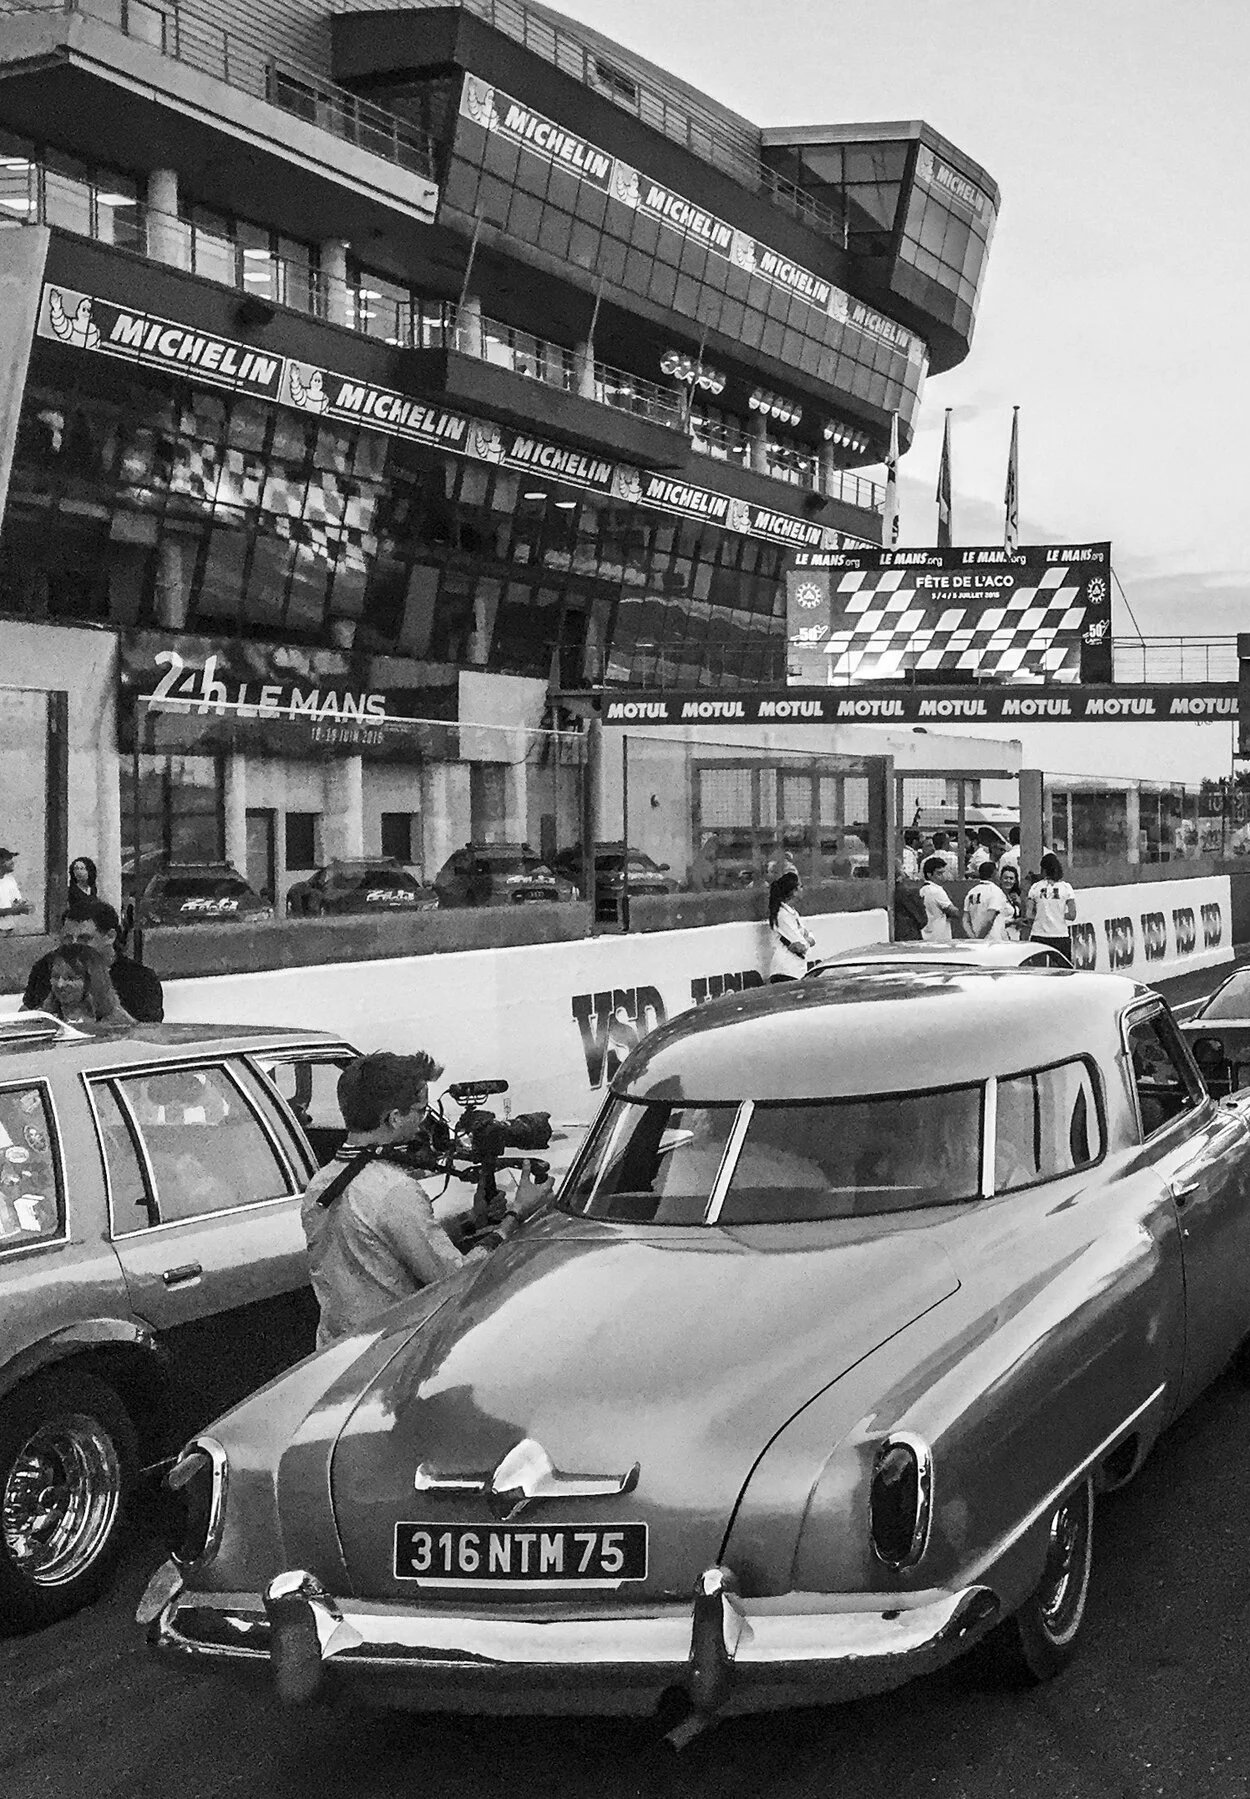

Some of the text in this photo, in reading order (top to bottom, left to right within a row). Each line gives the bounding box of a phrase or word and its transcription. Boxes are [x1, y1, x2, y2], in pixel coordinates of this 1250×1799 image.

[504, 104, 609, 178] MICHELIN
[646, 186, 732, 248] MICHELIN
[760, 252, 831, 303] MICHELIN
[852, 305, 909, 347] MICHELIN
[110, 314, 278, 385] MICHELIN
[336, 384, 466, 441] MICHELIN
[510, 437, 611, 484] MICHELIN
[646, 478, 728, 518] MICHELIN
[754, 512, 822, 545] MICHELIN
[795, 553, 809, 565] LE
[879, 553, 893, 565] LE
[962, 552, 976, 563] LE
[1046, 550, 1060, 562] LE
[916, 574, 1014, 588] FÊTE DE L'ACO
[237, 684, 283, 718] LE
[289, 688, 386, 725] MANS
[607, 702, 668, 719] MOTUL
[681, 702, 745, 718] MOTUL
[758, 701, 823, 717] MOTUL
[837, 700, 904, 717] MOTUL
[918, 699, 987, 716] MOTUL
[1001, 699, 1071, 715] MOTUL
[1084, 698, 1156, 715] MOTUL
[1169, 698, 1239, 714] MOTUL
